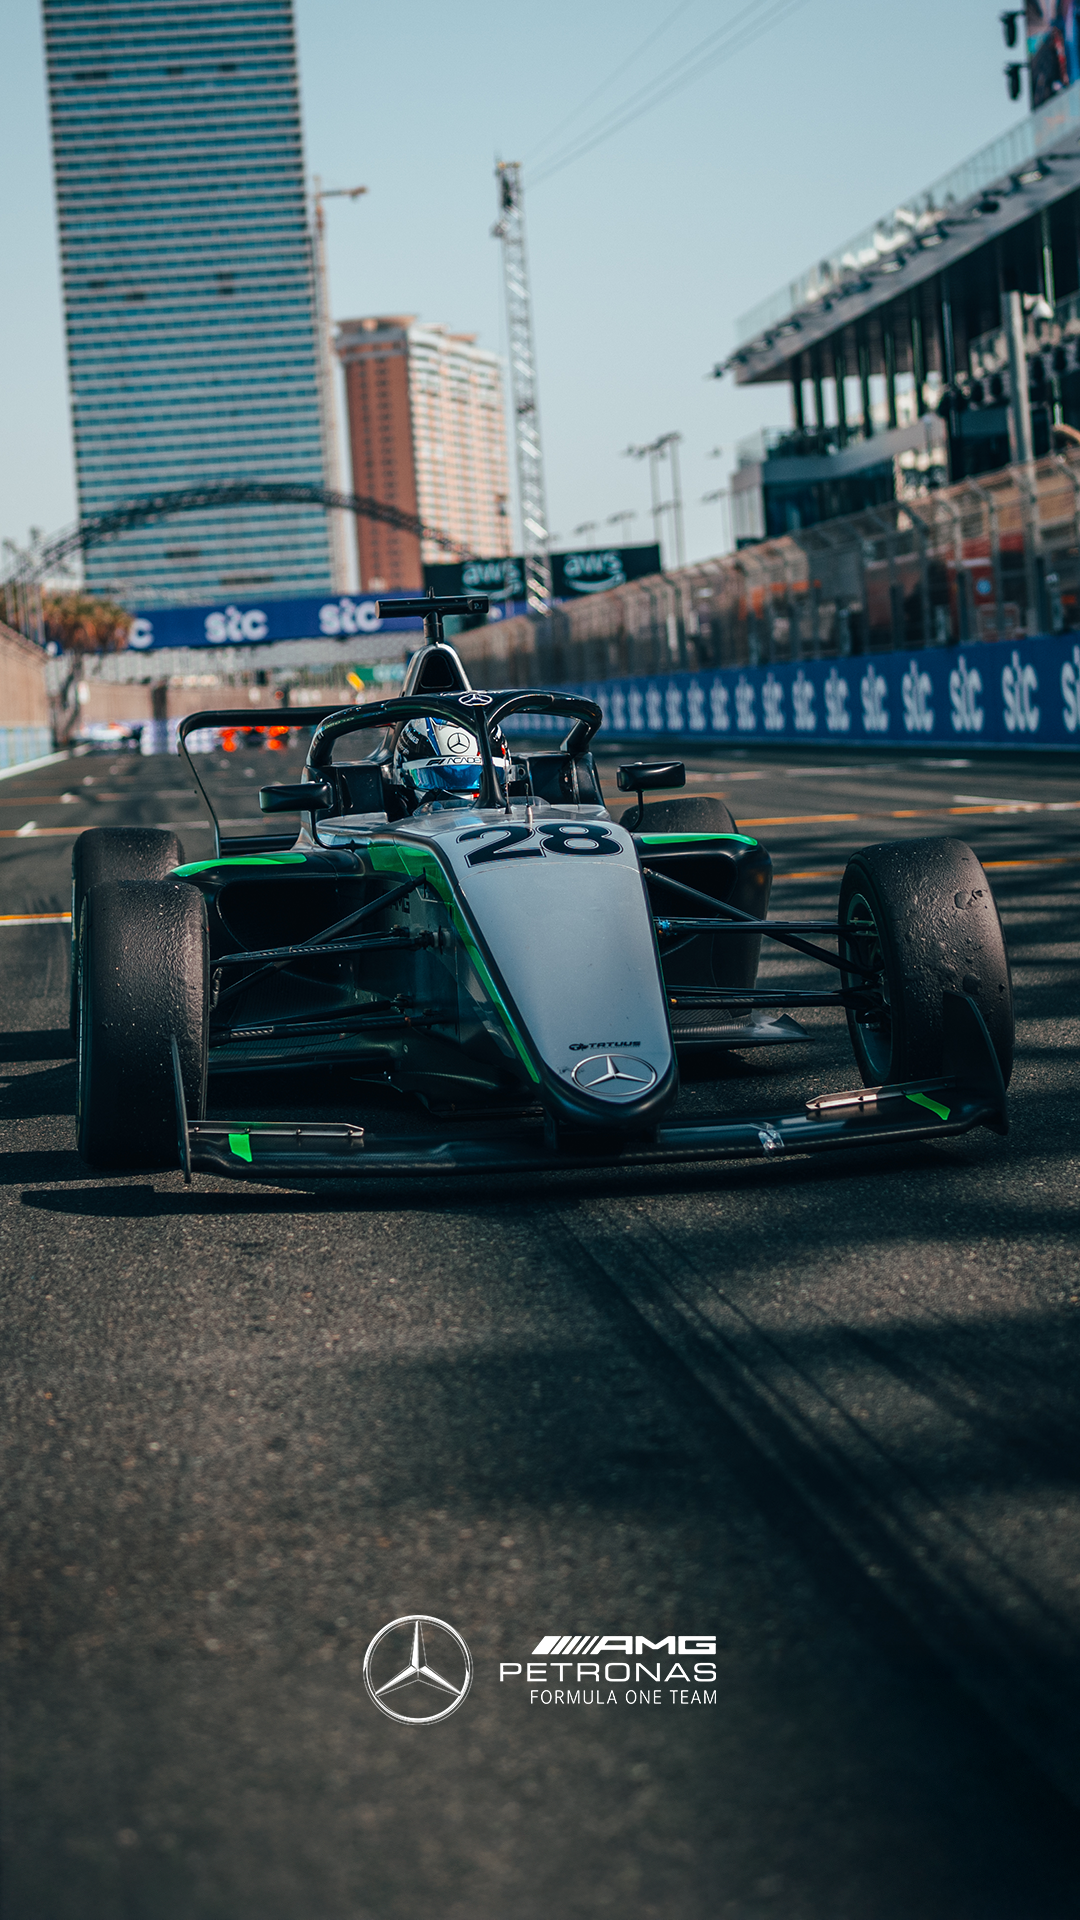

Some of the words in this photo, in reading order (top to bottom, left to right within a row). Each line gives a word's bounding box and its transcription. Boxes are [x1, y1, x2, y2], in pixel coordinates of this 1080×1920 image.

[462, 560, 521, 586] aws
[562, 550, 624, 578] aws
[204, 605, 268, 643] stc
[319, 598, 383, 636] stc
[949, 655, 984, 732] stc
[1002, 650, 1040, 732] stc
[456, 823, 623, 868] 28
